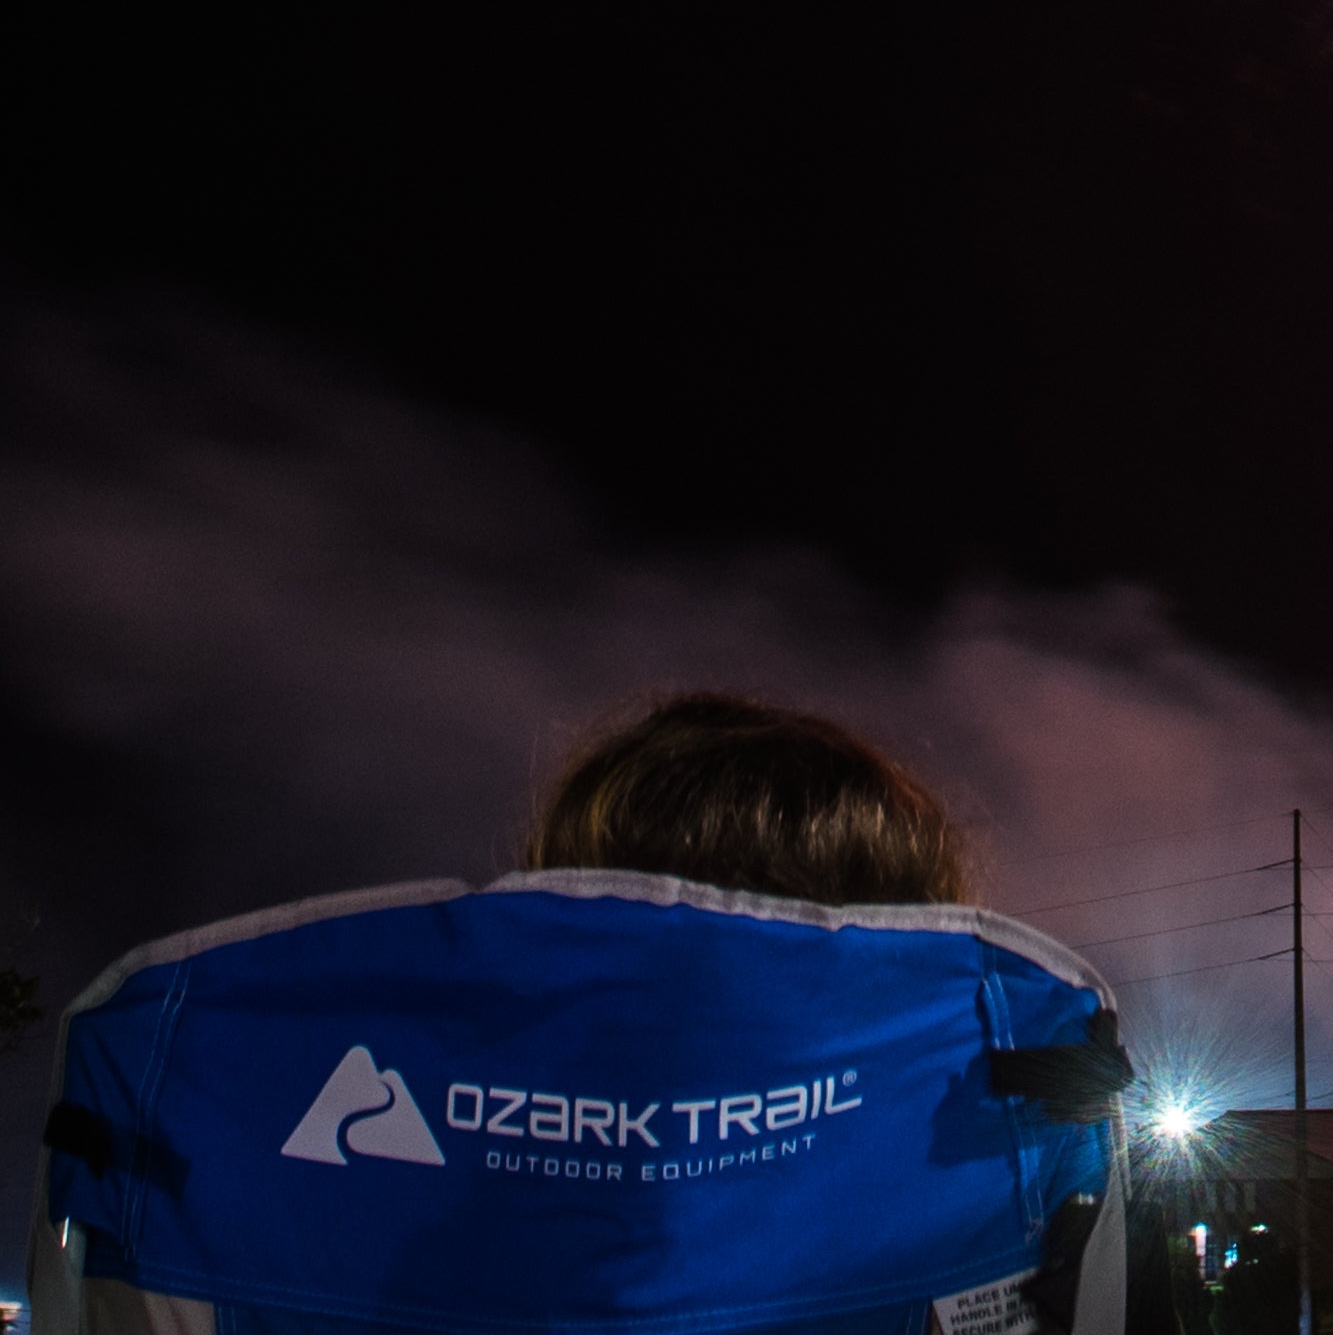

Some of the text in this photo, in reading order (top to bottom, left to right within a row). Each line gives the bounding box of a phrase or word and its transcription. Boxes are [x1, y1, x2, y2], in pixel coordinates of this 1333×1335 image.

[486, 1135, 815, 1182] OUTDOOR EQUIPMENT
[957, 1288, 1001, 1310] PLACE
[951, 1305, 1003, 1326] HANDLE
